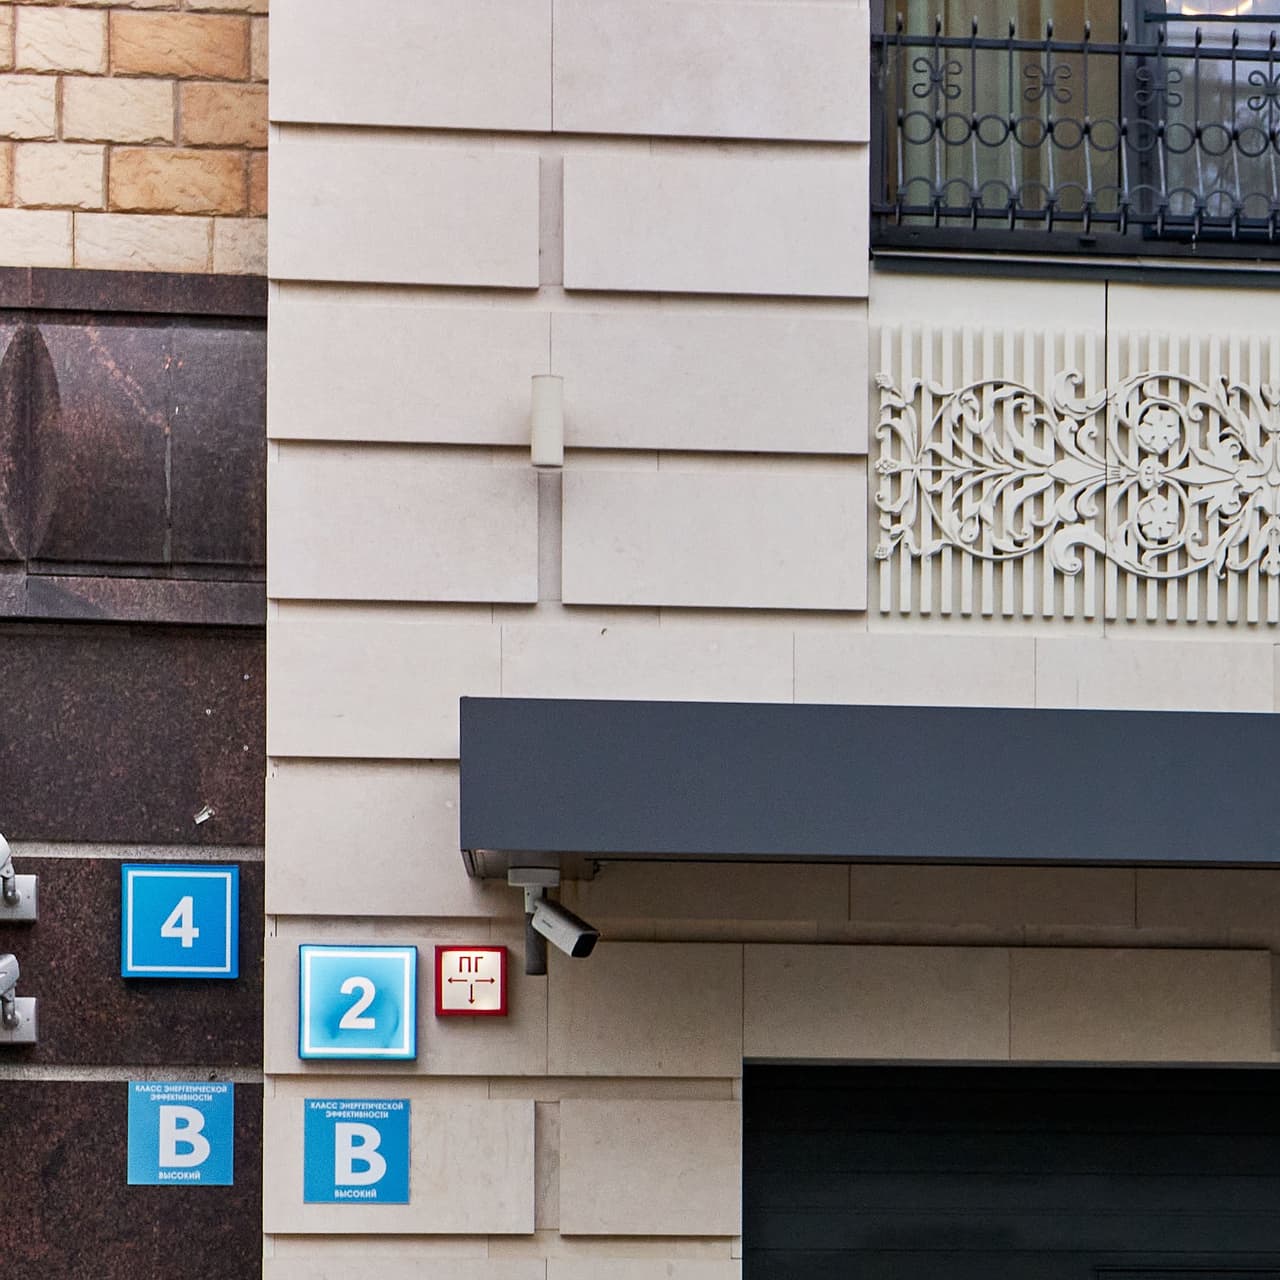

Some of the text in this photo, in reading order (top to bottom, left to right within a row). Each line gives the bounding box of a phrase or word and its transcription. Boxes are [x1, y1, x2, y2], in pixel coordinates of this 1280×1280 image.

[160, 895, 200, 948] 4
[458, 956, 485, 974] ПГ
[339, 976, 376, 1030] 2
[135, 1084, 161, 1093] КЛАСС
[310, 1101, 338, 1110] КЛАСС
[158, 1170, 201, 1180] ВЫСОКИЙ
[334, 1188, 377, 1199] ВЫСОКИЙ
